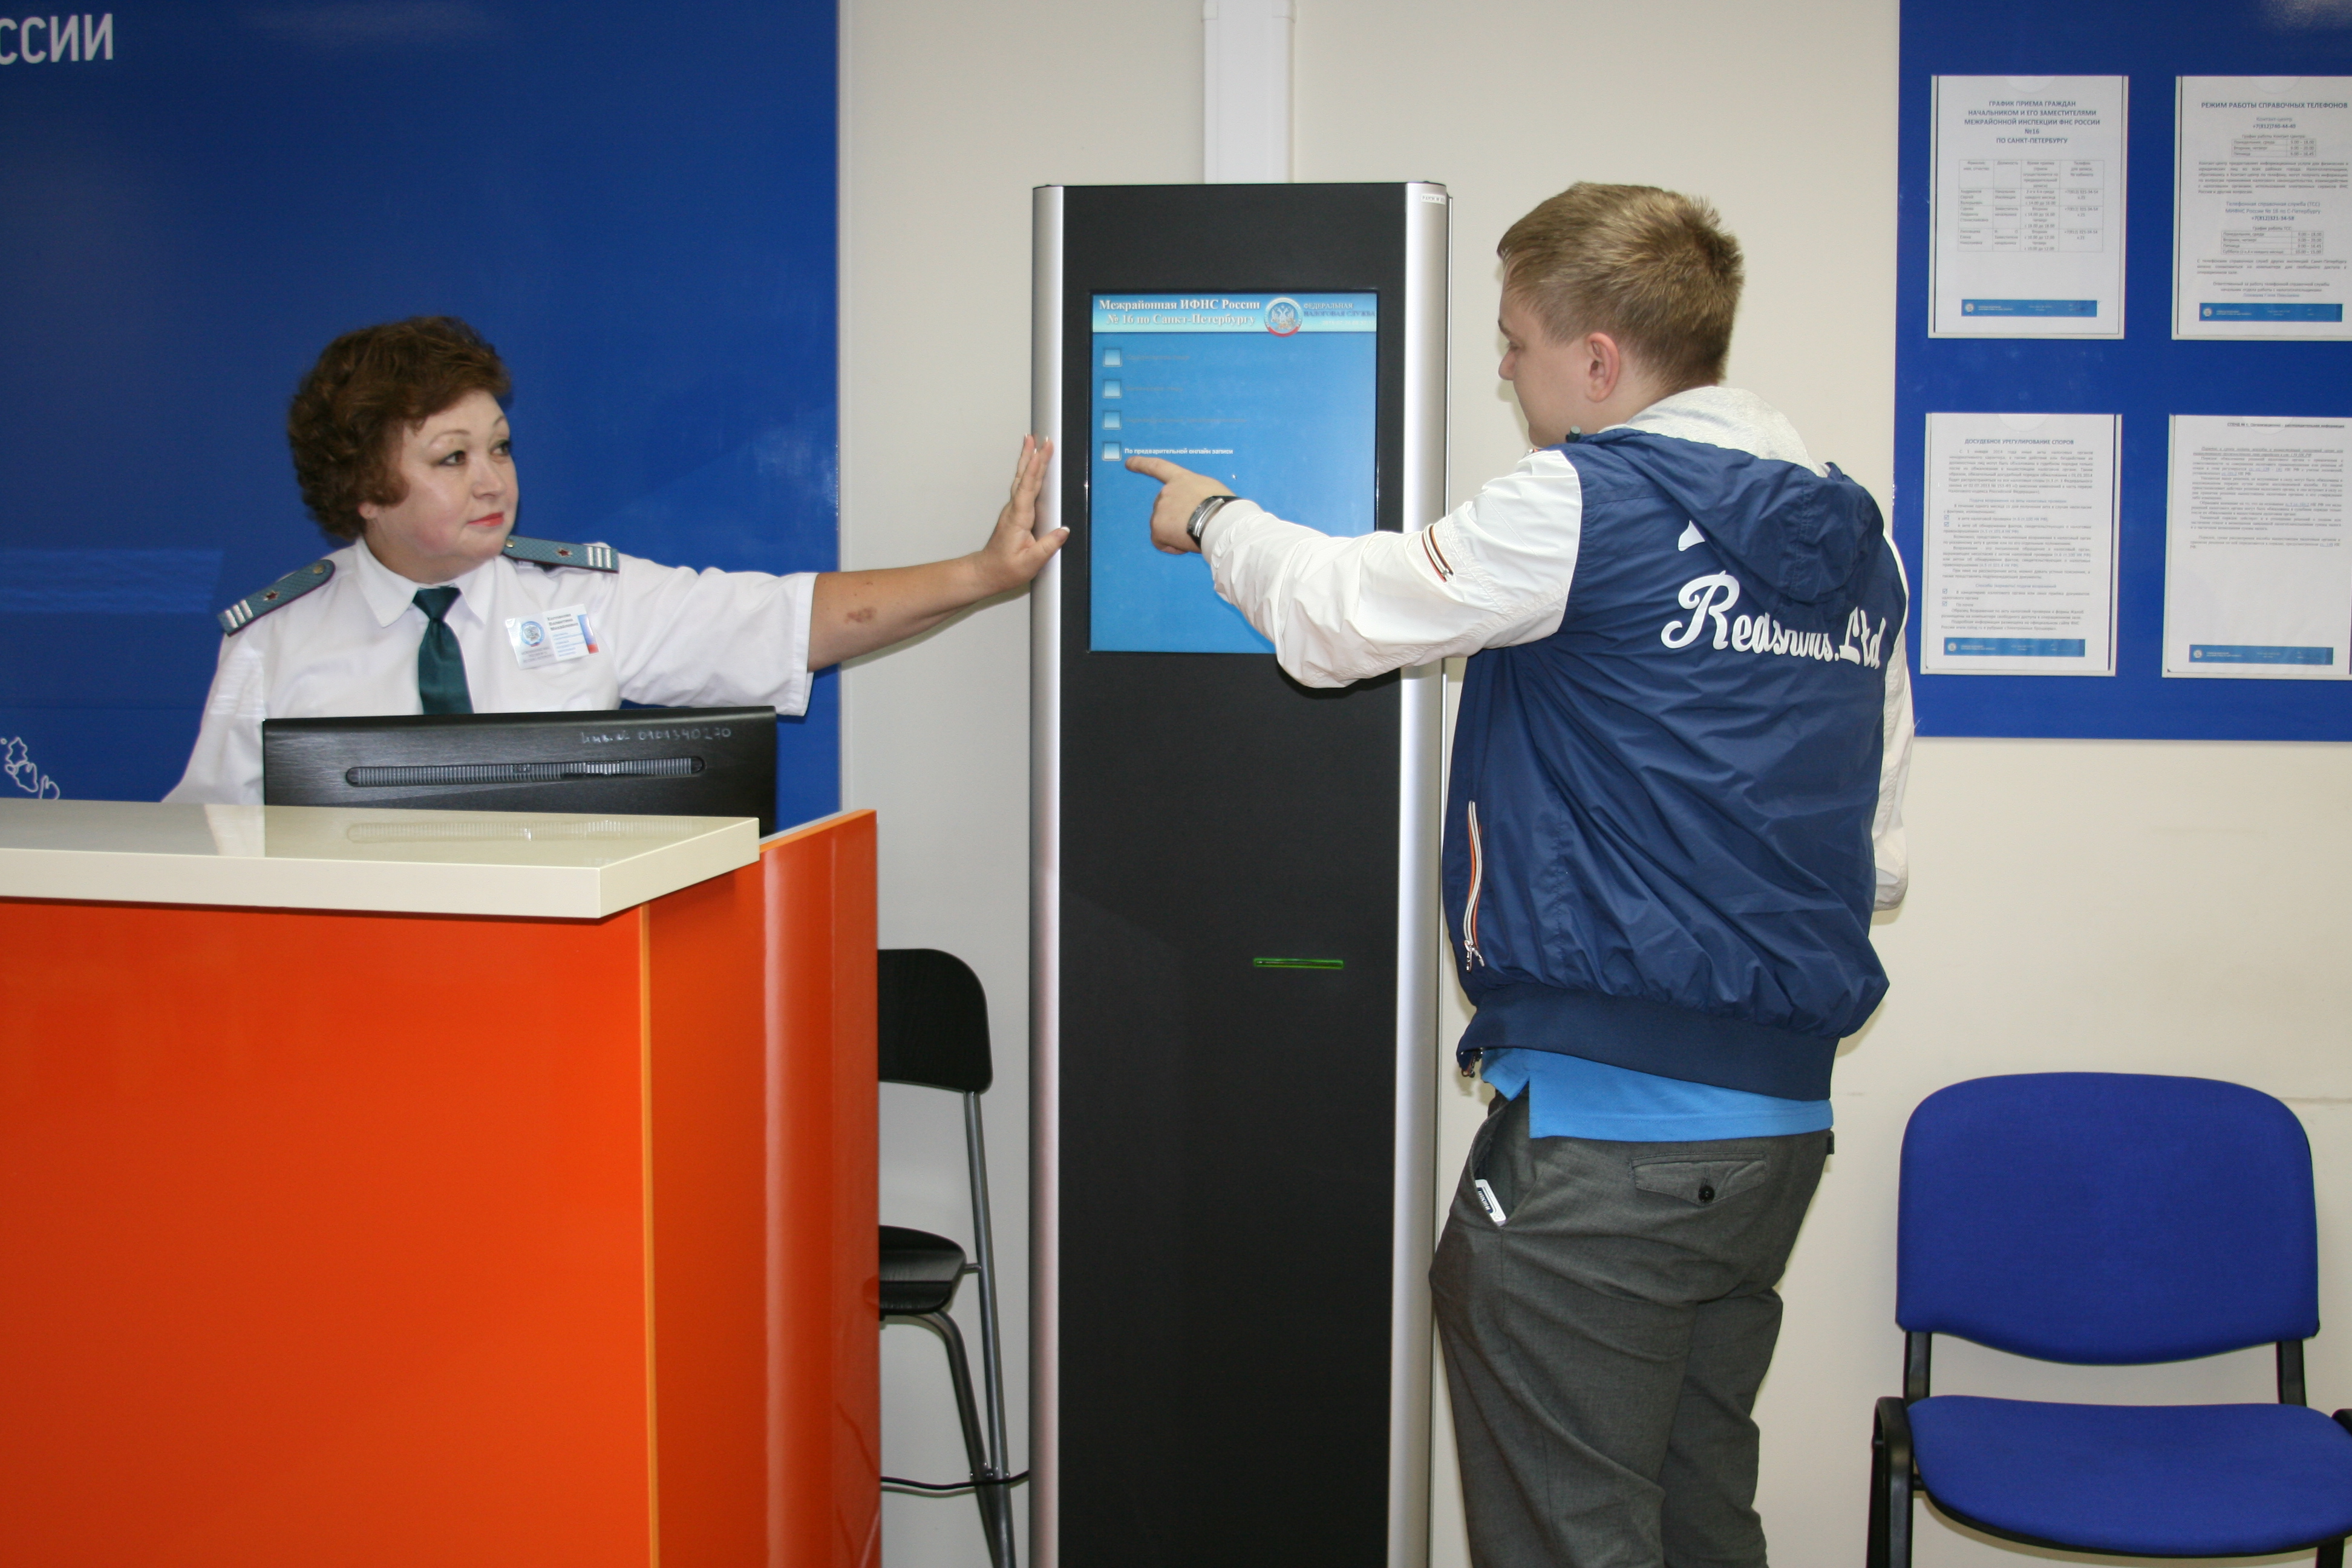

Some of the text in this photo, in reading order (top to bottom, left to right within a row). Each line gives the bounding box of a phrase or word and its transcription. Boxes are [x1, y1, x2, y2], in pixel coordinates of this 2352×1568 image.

[1100, 299, 1260, 312] Межрайонная ИФНС России
[1106, 315, 1119, 324] №
[1122, 314, 1133, 324] 16
[1153, 314, 1255, 325] Санкт-Петербургу
